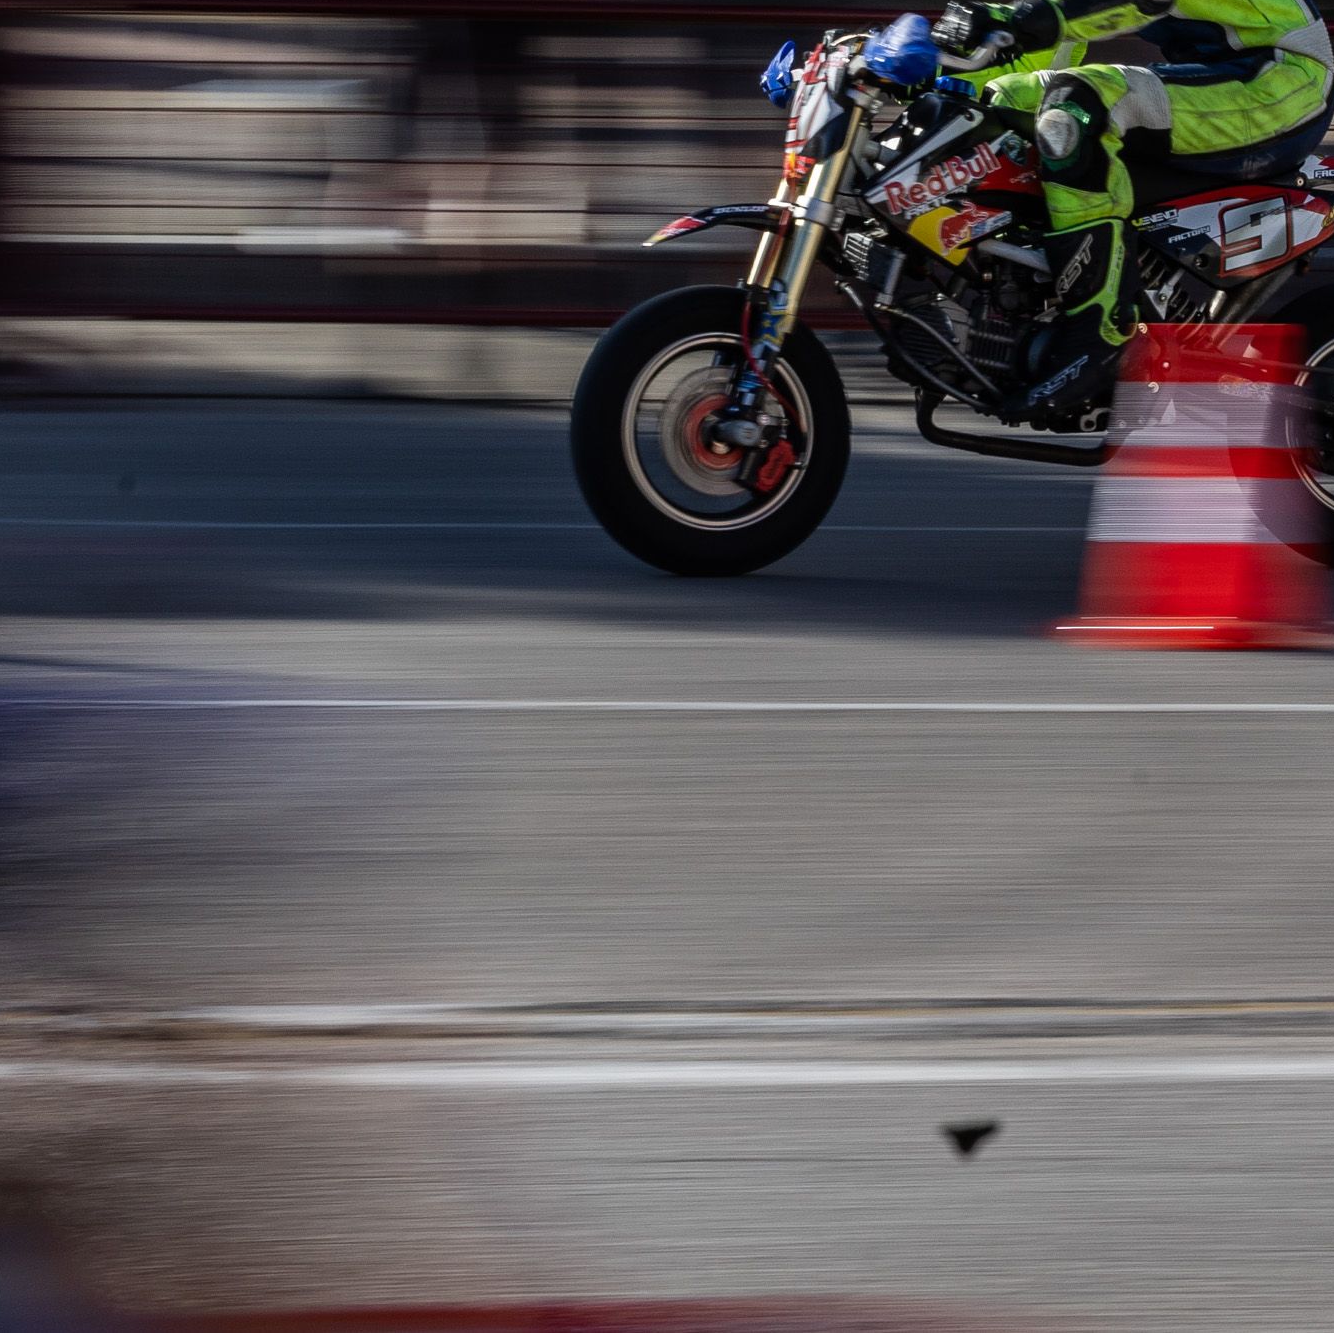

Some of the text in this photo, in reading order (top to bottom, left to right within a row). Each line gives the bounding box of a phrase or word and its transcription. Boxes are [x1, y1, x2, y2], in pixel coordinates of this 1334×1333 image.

[884, 141, 1002, 215] Red Bull
[1056, 233, 1093, 295] RST
[1168, 225, 1210, 244] FACTORY
